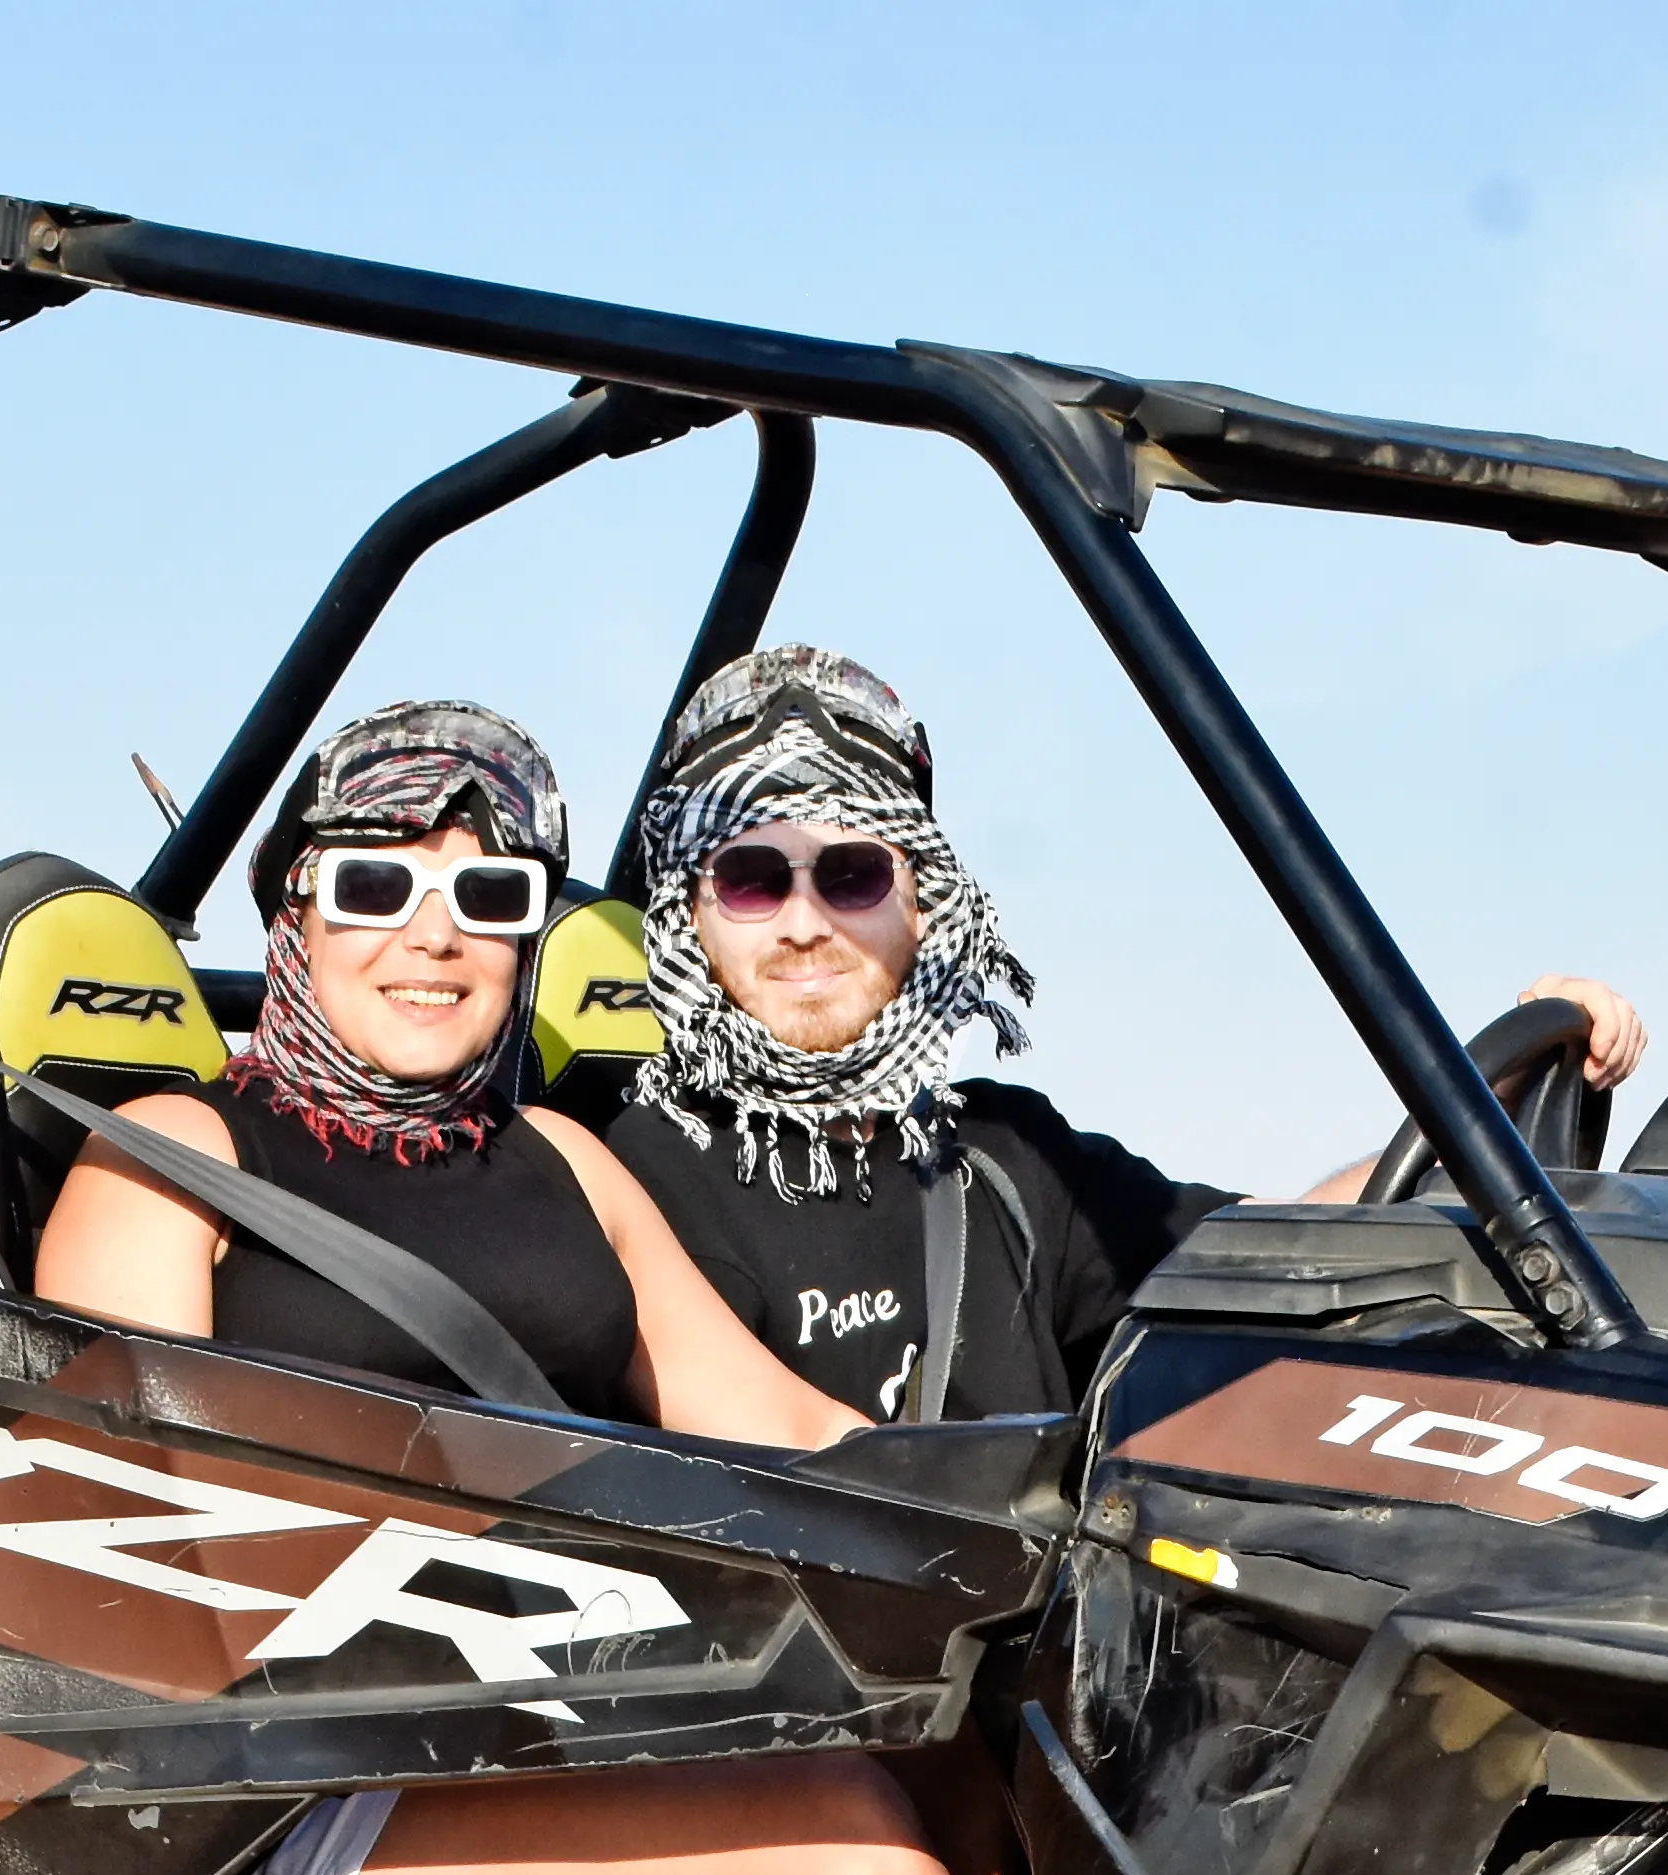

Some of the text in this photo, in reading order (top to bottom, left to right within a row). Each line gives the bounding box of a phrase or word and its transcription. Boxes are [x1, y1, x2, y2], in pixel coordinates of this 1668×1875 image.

[48, 977, 187, 1027] RZR
[576, 978, 652, 1016] RZ
[797, 1288, 902, 1345] Peace
